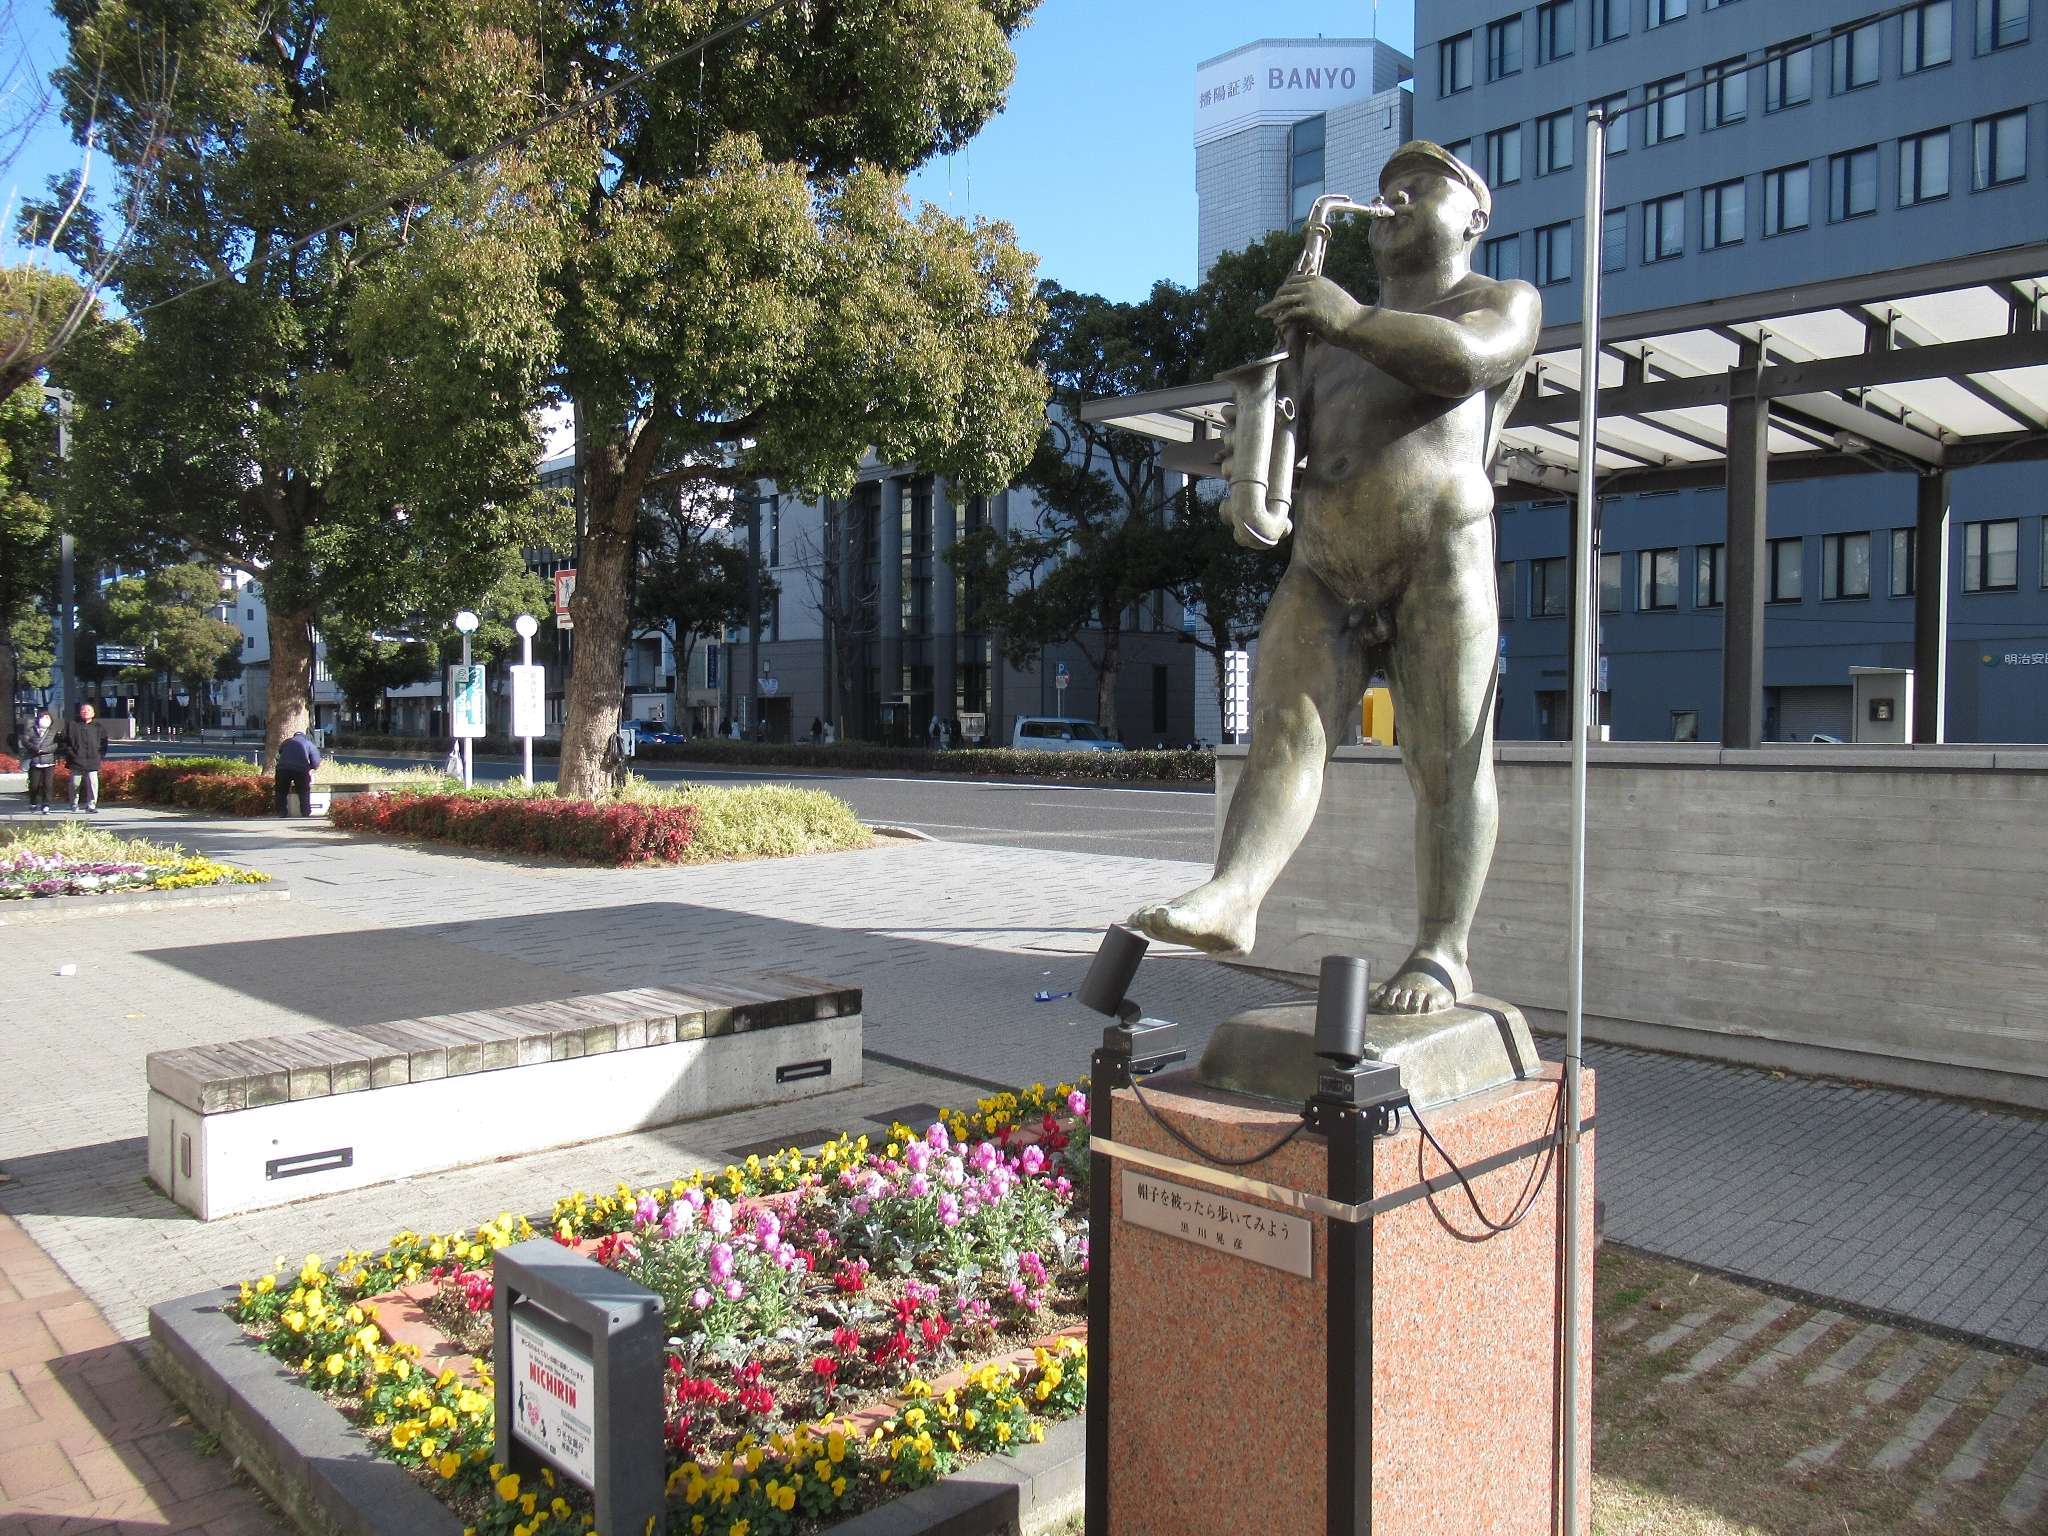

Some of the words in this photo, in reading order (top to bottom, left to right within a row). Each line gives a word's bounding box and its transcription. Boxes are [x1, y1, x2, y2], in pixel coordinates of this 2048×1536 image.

[1268, 67, 1356, 90] BANYO
[1058, 663, 1065, 674] P
[2004, 653, 2048, 665] 明治安
[1137, 1181, 1289, 1241] 帽子を被ったら歩いてみよう
[529, 1361, 577, 1409] NICHIRIN
